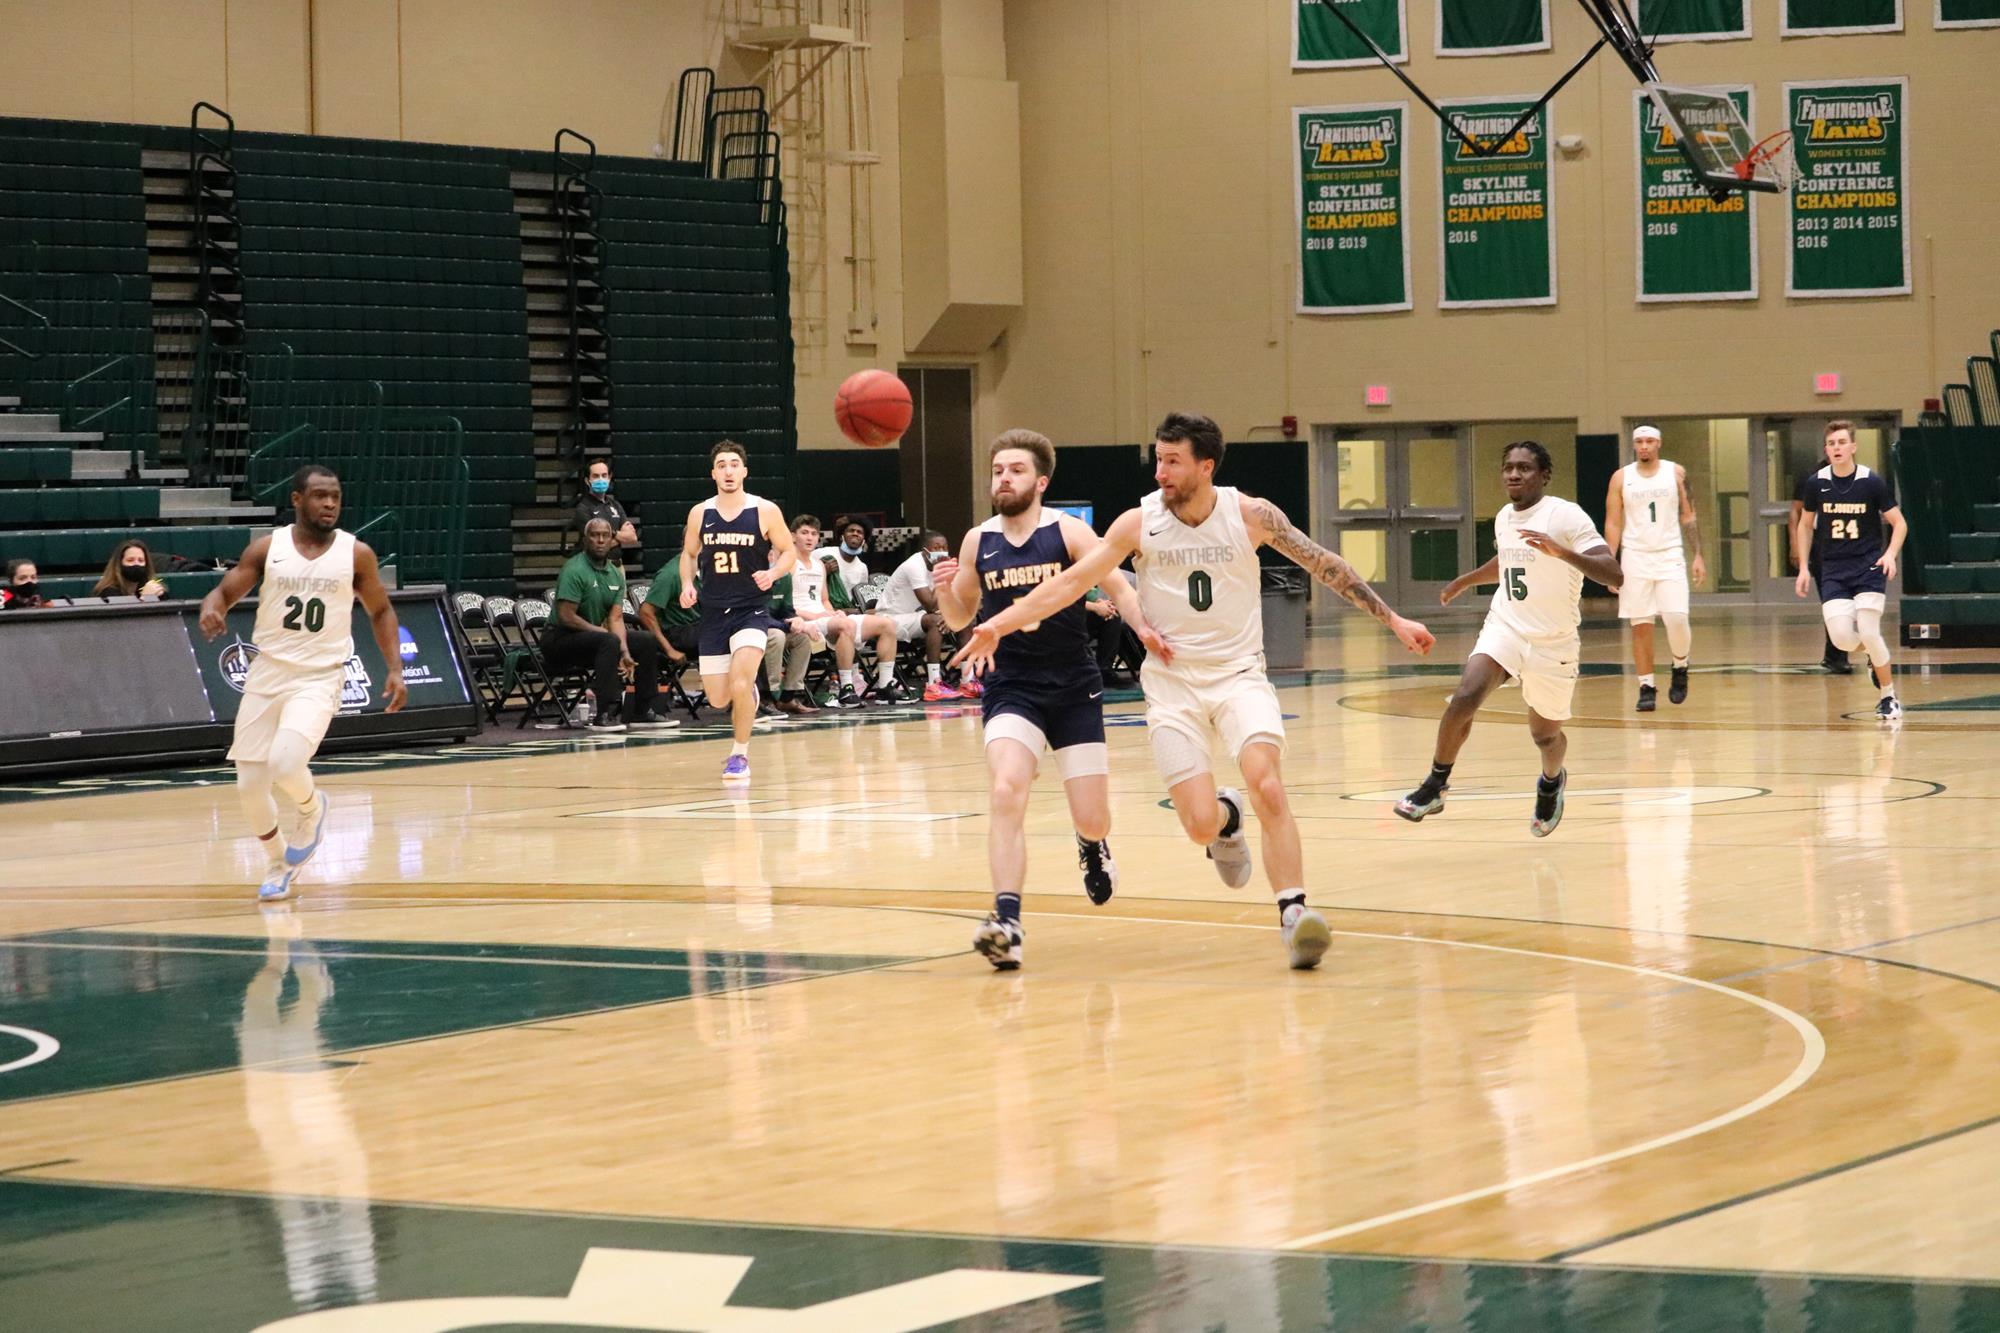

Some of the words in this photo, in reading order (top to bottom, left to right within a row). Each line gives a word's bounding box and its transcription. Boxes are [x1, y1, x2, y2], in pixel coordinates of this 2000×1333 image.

[1801, 97, 1891, 121] FARMINGDALE
[1309, 119, 1393, 144] FARMINGDALE
[1810, 117, 1882, 140] RAMS
[1318, 139, 1385, 162] RAMS
[1854, 147, 1887, 157] TENNIS
[1813, 162, 1881, 176] SKYLINE
[1320, 183, 1383, 198] SKYLINE
[1463, 176, 1527, 190] SKYLINE
[1799, 177, 1894, 192] CONFERENCE
[1308, 197, 1396, 213] CONFERENCE
[1449, 190, 1541, 206] CONFERENCE
[1796, 192, 1897, 209] CHAMPIONS
[1307, 212, 1397, 230] CHAMPIONS
[1447, 205, 1544, 222] CHAMPIONS
[1648, 223, 1678, 236] 2016
[1797, 217, 1828, 230] 2013
[1833, 216, 1863, 229] 2014
[1868, 215, 1898, 228] 2015
[1306, 238, 1334, 250] 2018
[1339, 236, 1367, 249] 2019
[1448, 231, 1478, 243] 2016
[1797, 236, 1828, 249] 2016
[1648, 501, 1656, 522] 1
[1832, 519, 1859, 539] 24
[714, 551, 740, 573] 21
[1158, 545, 1234, 567] PANTHERS
[277, 576, 339, 593] PANTHERS
[1187, 570, 1213, 612] 0
[1504, 568, 1528, 601] 15
[283, 595, 326, 633] 20
